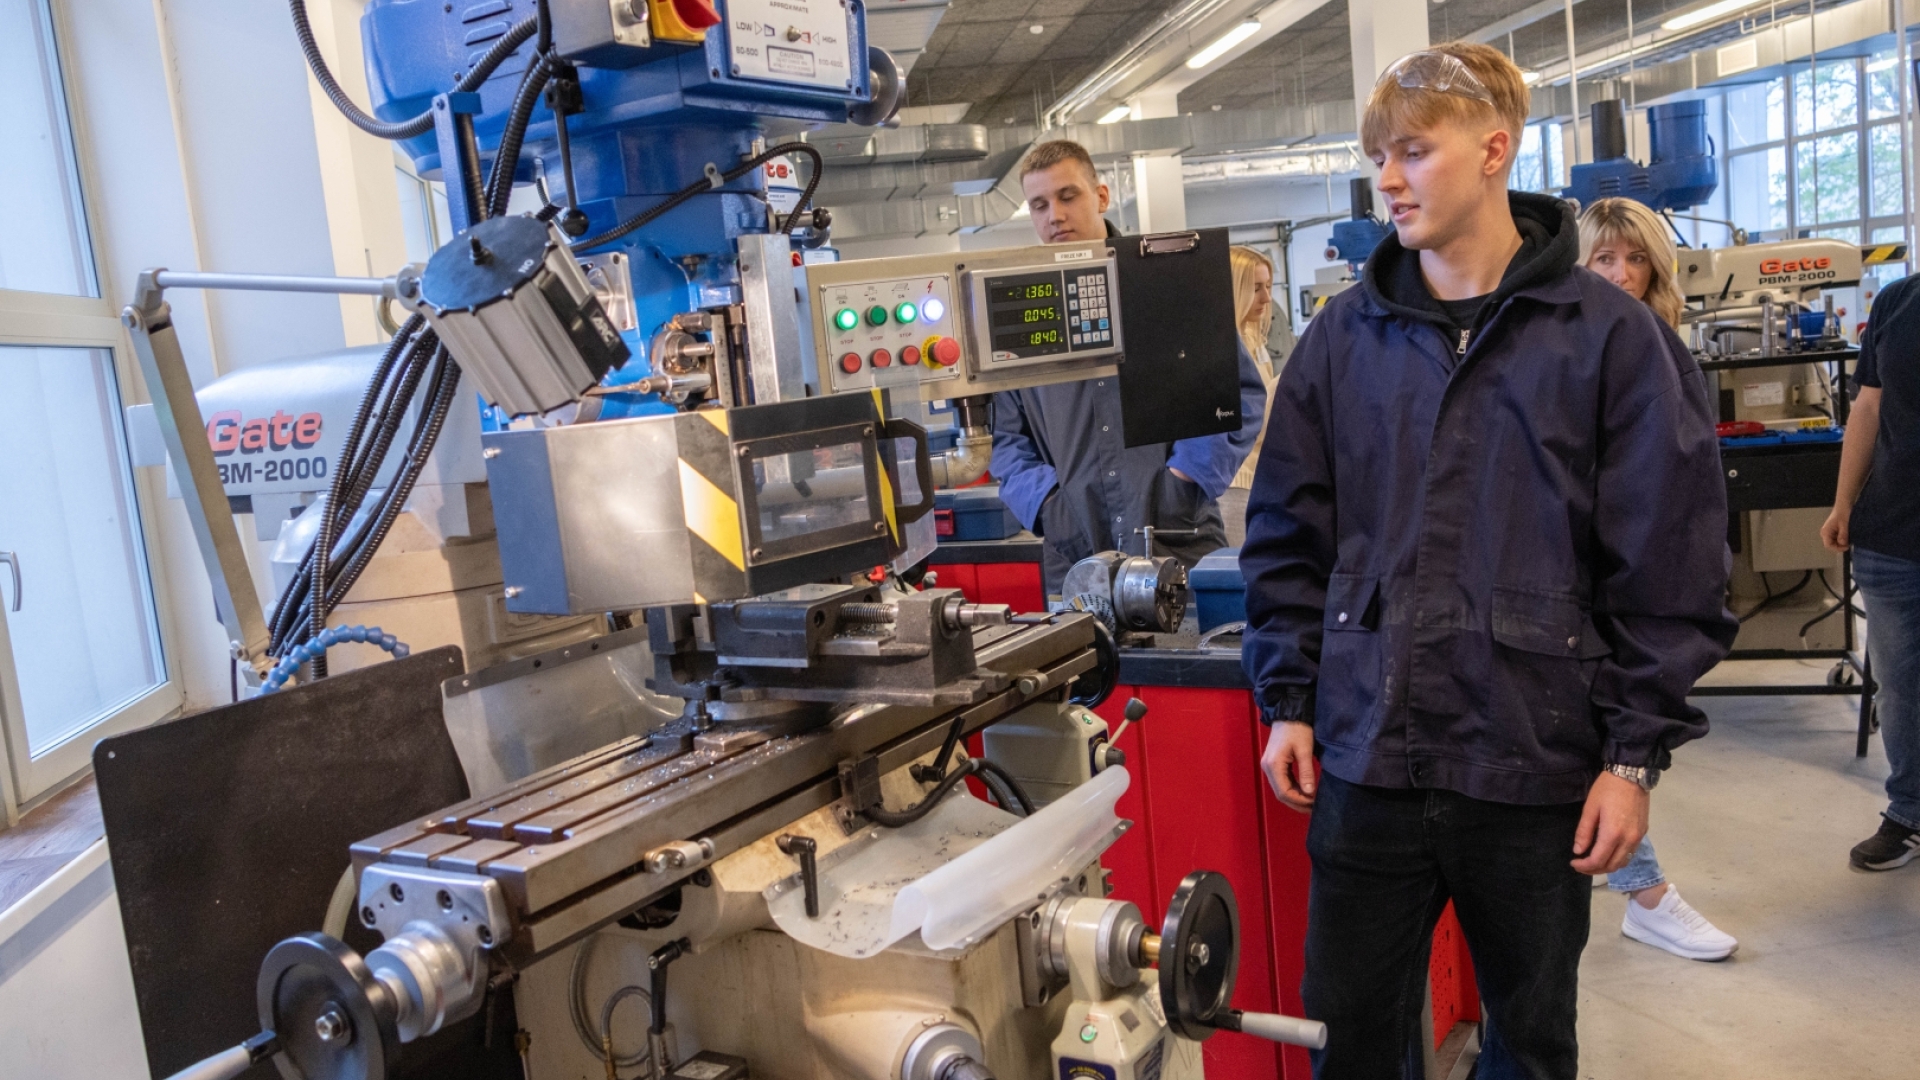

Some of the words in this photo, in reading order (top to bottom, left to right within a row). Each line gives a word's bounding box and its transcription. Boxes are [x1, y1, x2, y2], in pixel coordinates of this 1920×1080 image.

[769, 1, 809, 14] APPROXIMATE
[735, 21, 753, 31] LOW
[822, 36, 837, 44] HIGH
[779, 51, 805, 60] CAUTION
[766, 161, 788, 179] te
[1759, 257, 1832, 277] Gate
[1758, 270, 1836, 285] PBM-2000
[1024, 307, 1055, 322] 0.045
[1030, 330, 1057, 345] 1.840
[206, 409, 323, 457] Gate
[218, 456, 327, 484] BM-2000
